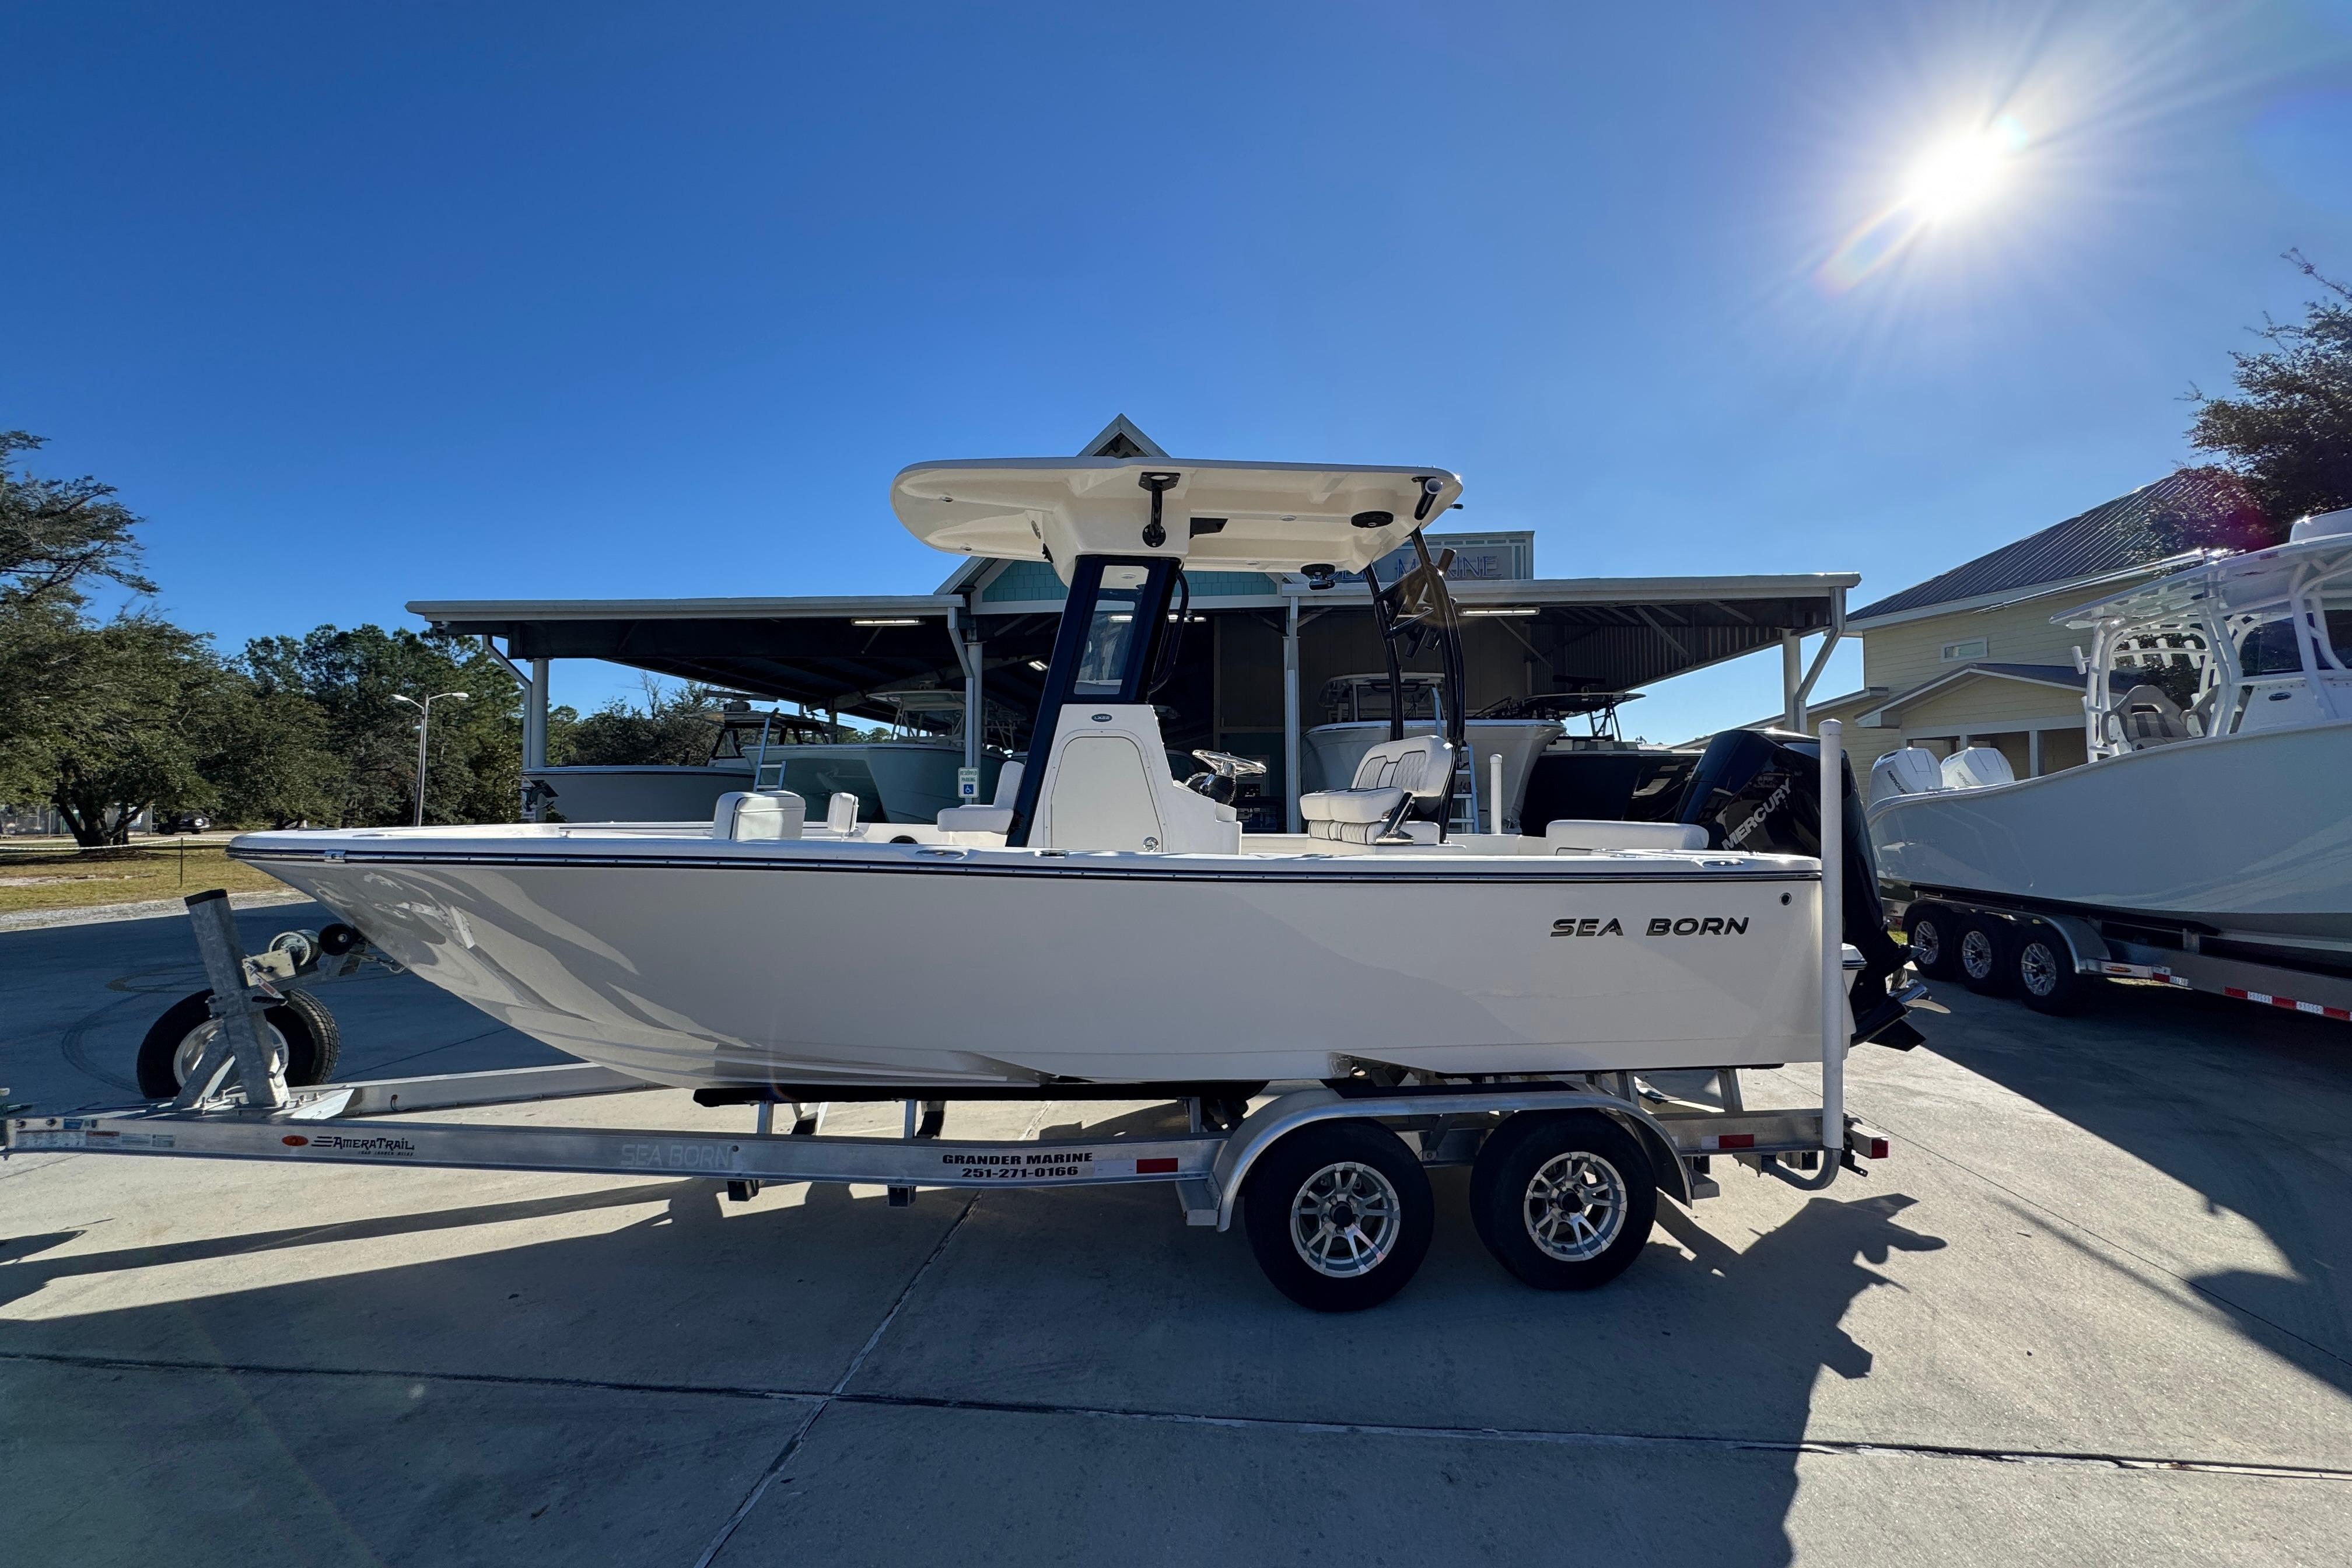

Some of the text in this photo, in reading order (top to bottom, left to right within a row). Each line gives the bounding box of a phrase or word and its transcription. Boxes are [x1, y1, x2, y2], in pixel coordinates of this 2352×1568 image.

[1397, 555, 1503, 579] MINE
[1887, 770, 1907, 794] MERCUR
[1721, 777, 1791, 850] MERCURY
[1550, 917, 1749, 937] SEA BORN
[620, 1143, 730, 1167] SEA BORN
[942, 1152, 1093, 1165] GRANDER MARINE
[962, 1166, 1079, 1178] 251-271-0166
